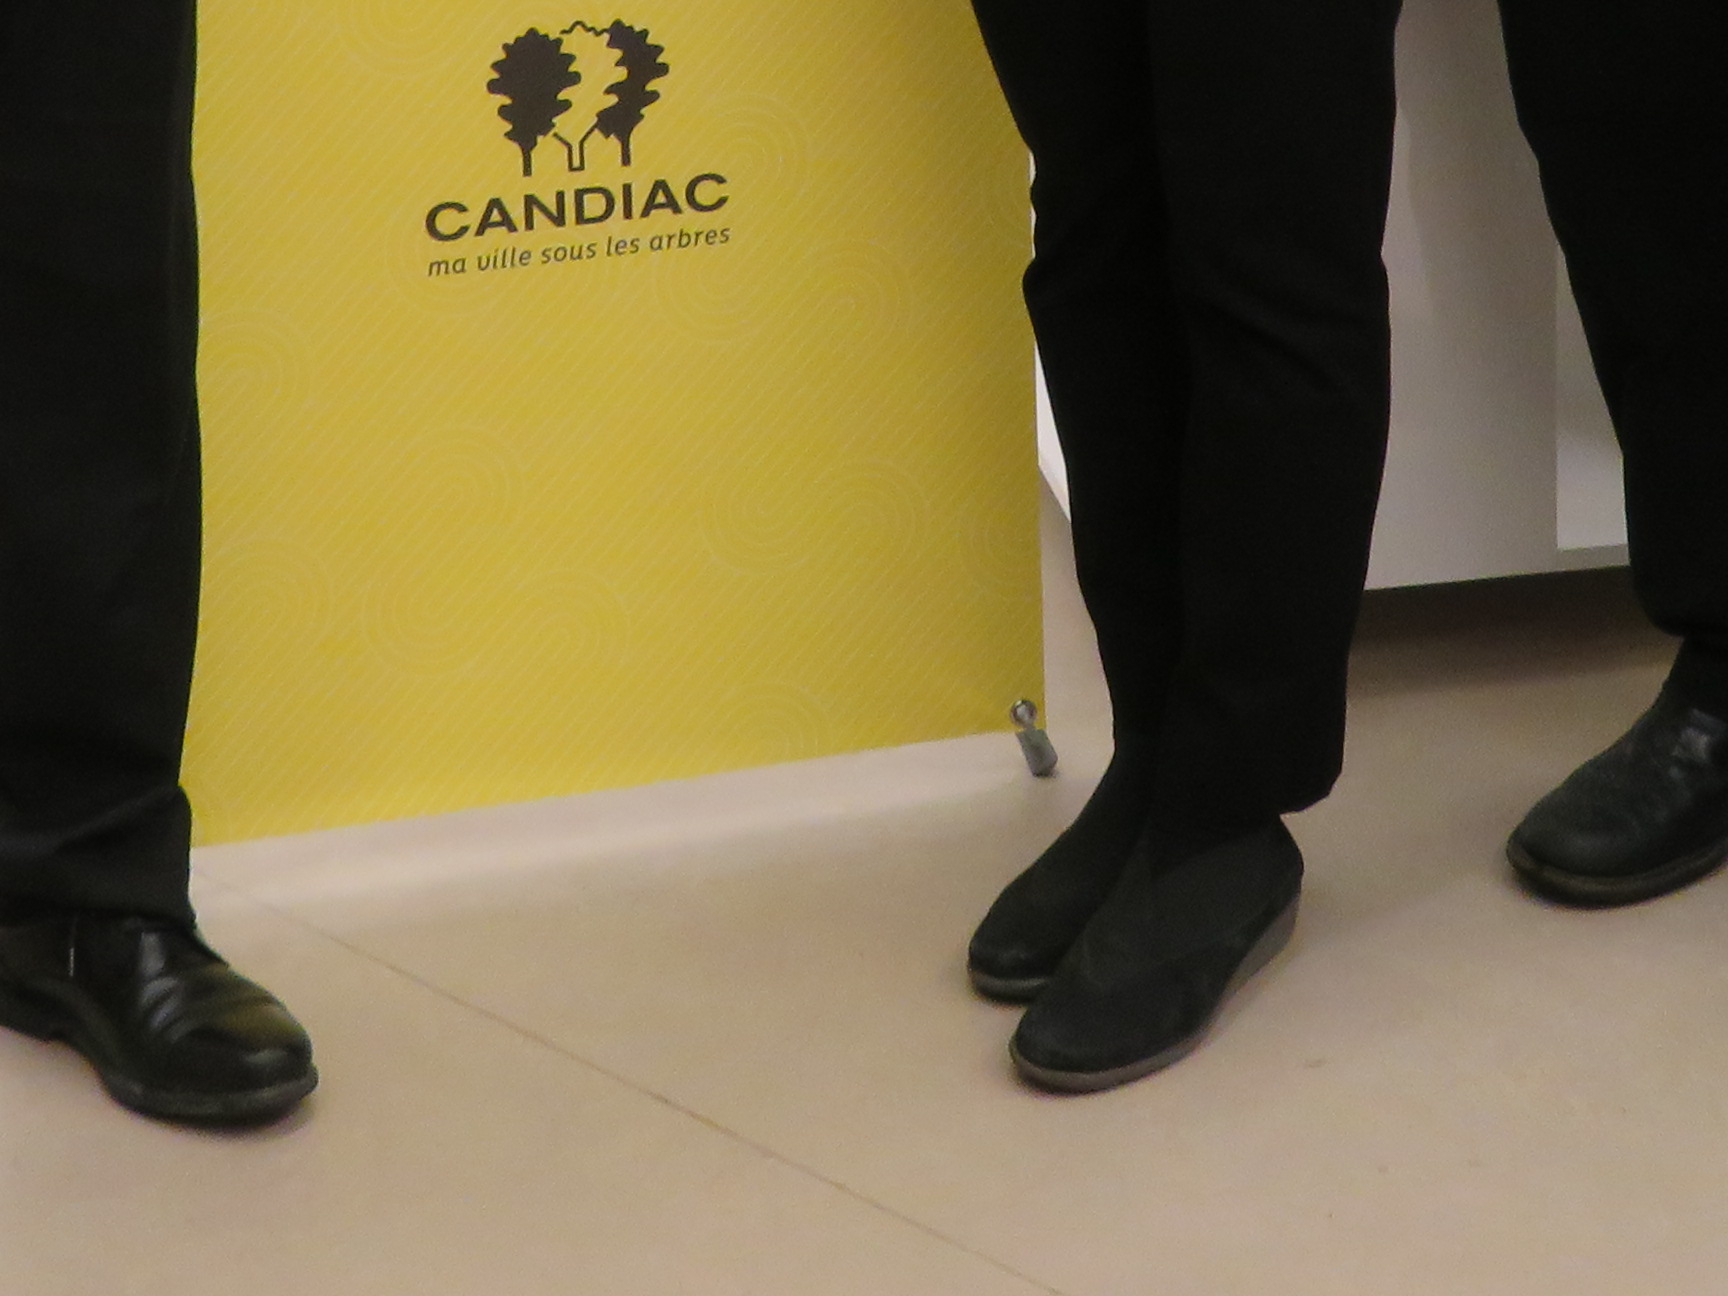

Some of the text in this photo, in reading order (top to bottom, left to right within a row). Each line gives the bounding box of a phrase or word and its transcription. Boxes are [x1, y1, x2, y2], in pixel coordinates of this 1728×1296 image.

[425, 173, 730, 242] CANDIAC
[428, 226, 731, 277] ma ville sous les arbres
